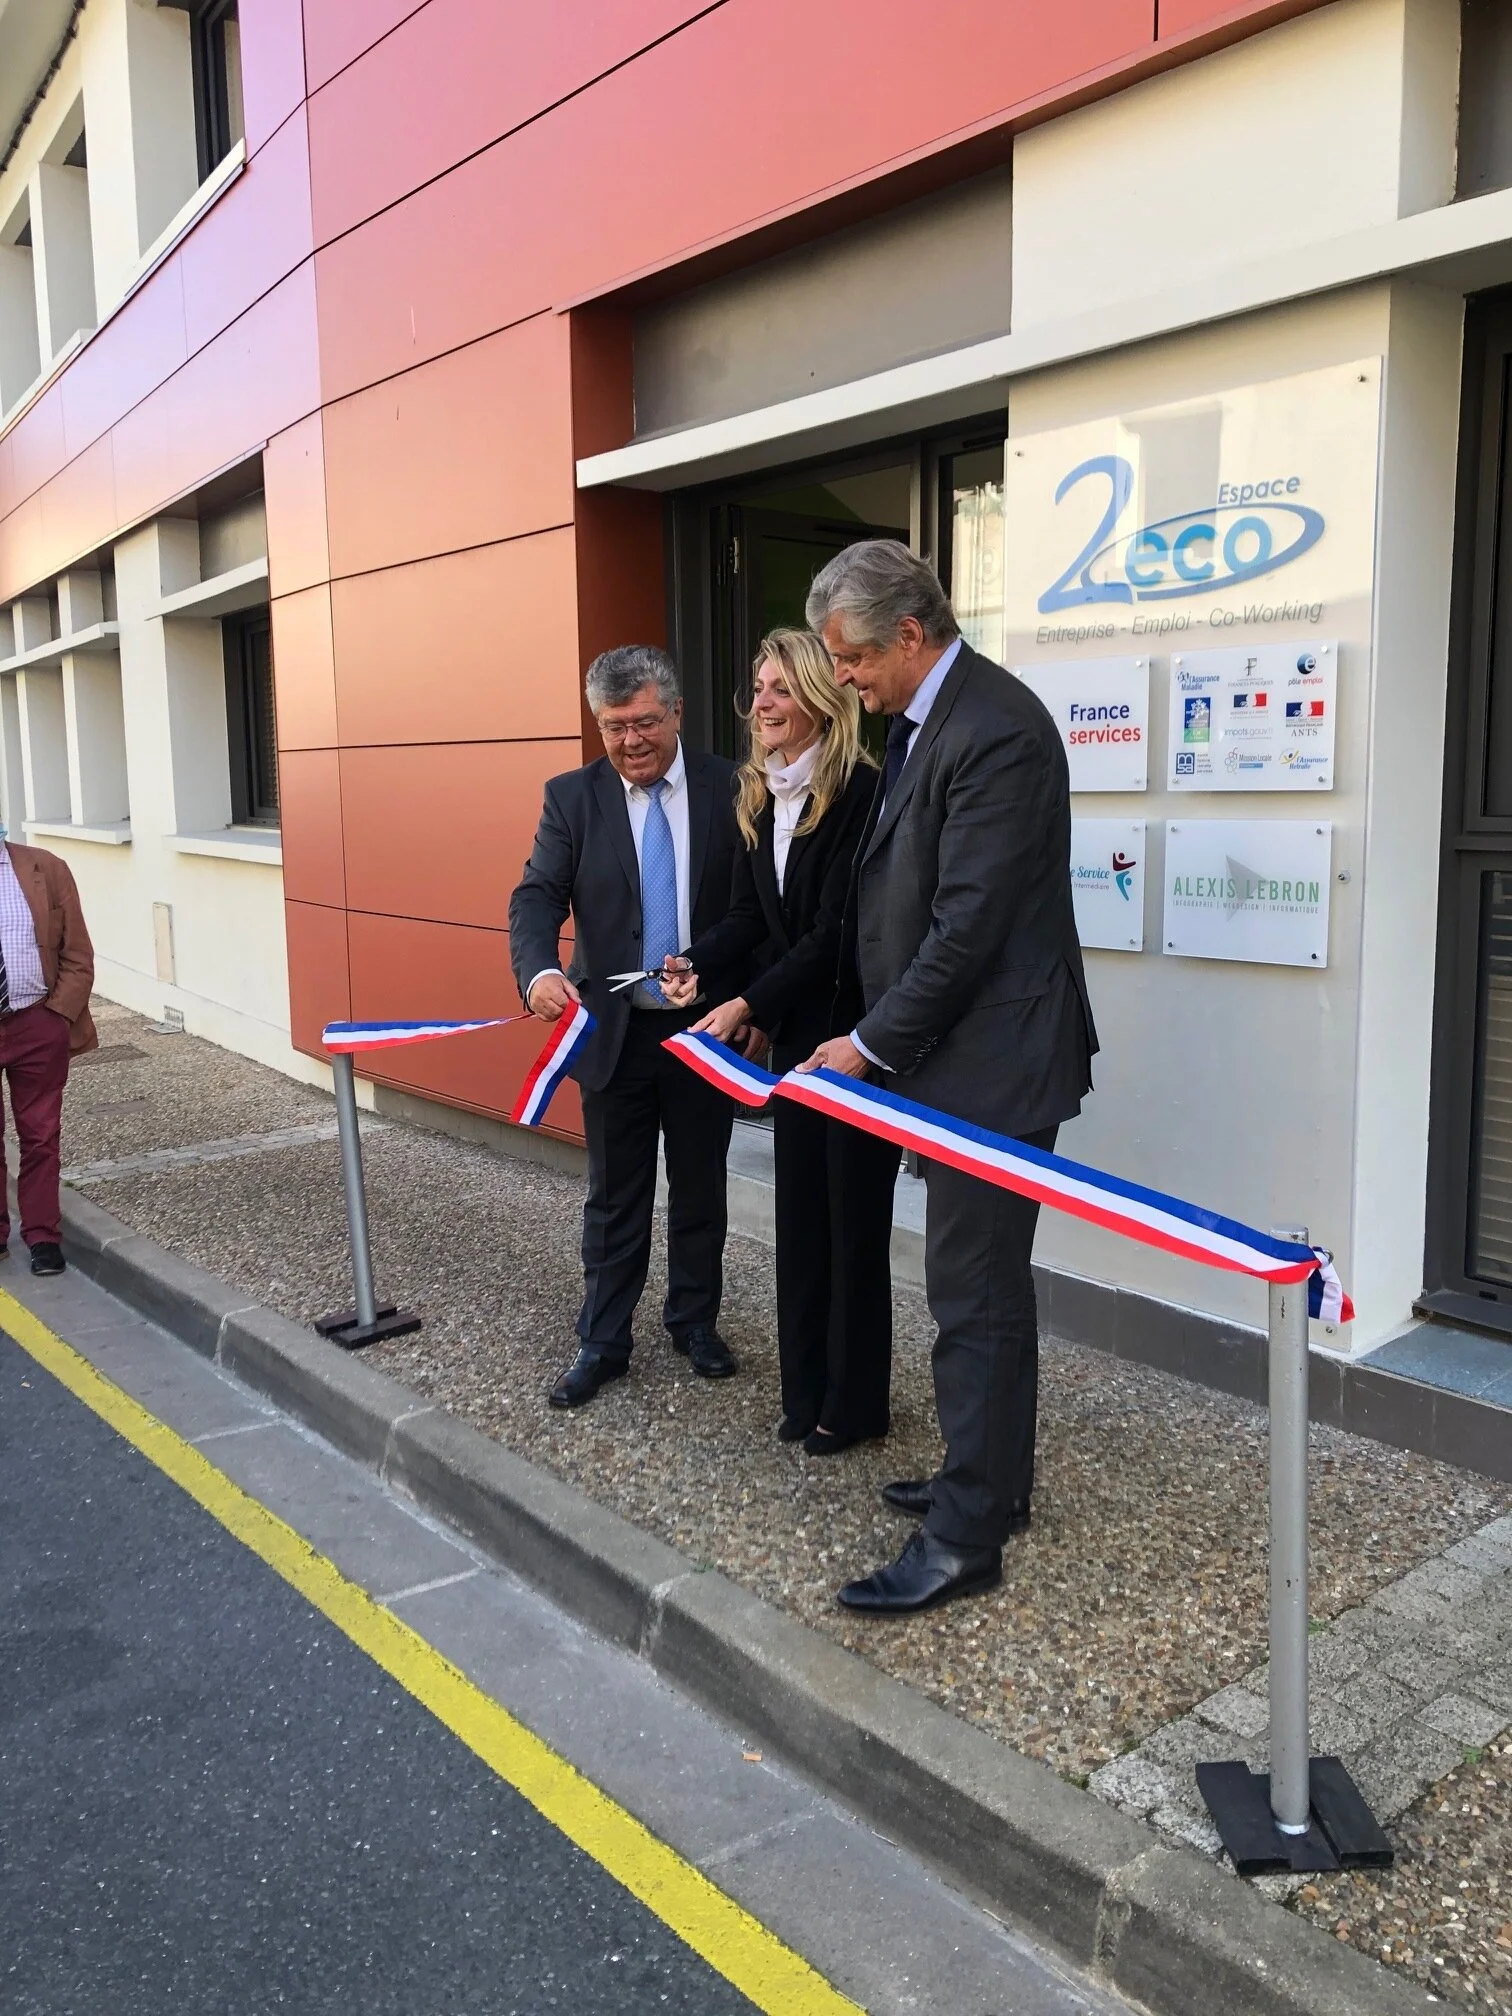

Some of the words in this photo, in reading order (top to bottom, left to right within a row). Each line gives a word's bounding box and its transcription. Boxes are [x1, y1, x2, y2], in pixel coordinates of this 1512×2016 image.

[1217, 476, 1301, 506] Espace
[1036, 622, 1115, 645] Entreprise
[1131, 610, 1191, 636] Emploi
[1209, 600, 1323, 628] Co-Working
[1302, 676, 1323, 686] emploi
[1070, 703, 1130, 722] France
[1069, 724, 1141, 745] services
[1291, 728, 1318, 737] ANTS
[1077, 865, 1111, 880] Service
[1173, 876, 1236, 898] ALEXIS
[1246, 879, 1320, 903] LEBRON
[1269, 904, 1319, 914] INFORMATIQUE
